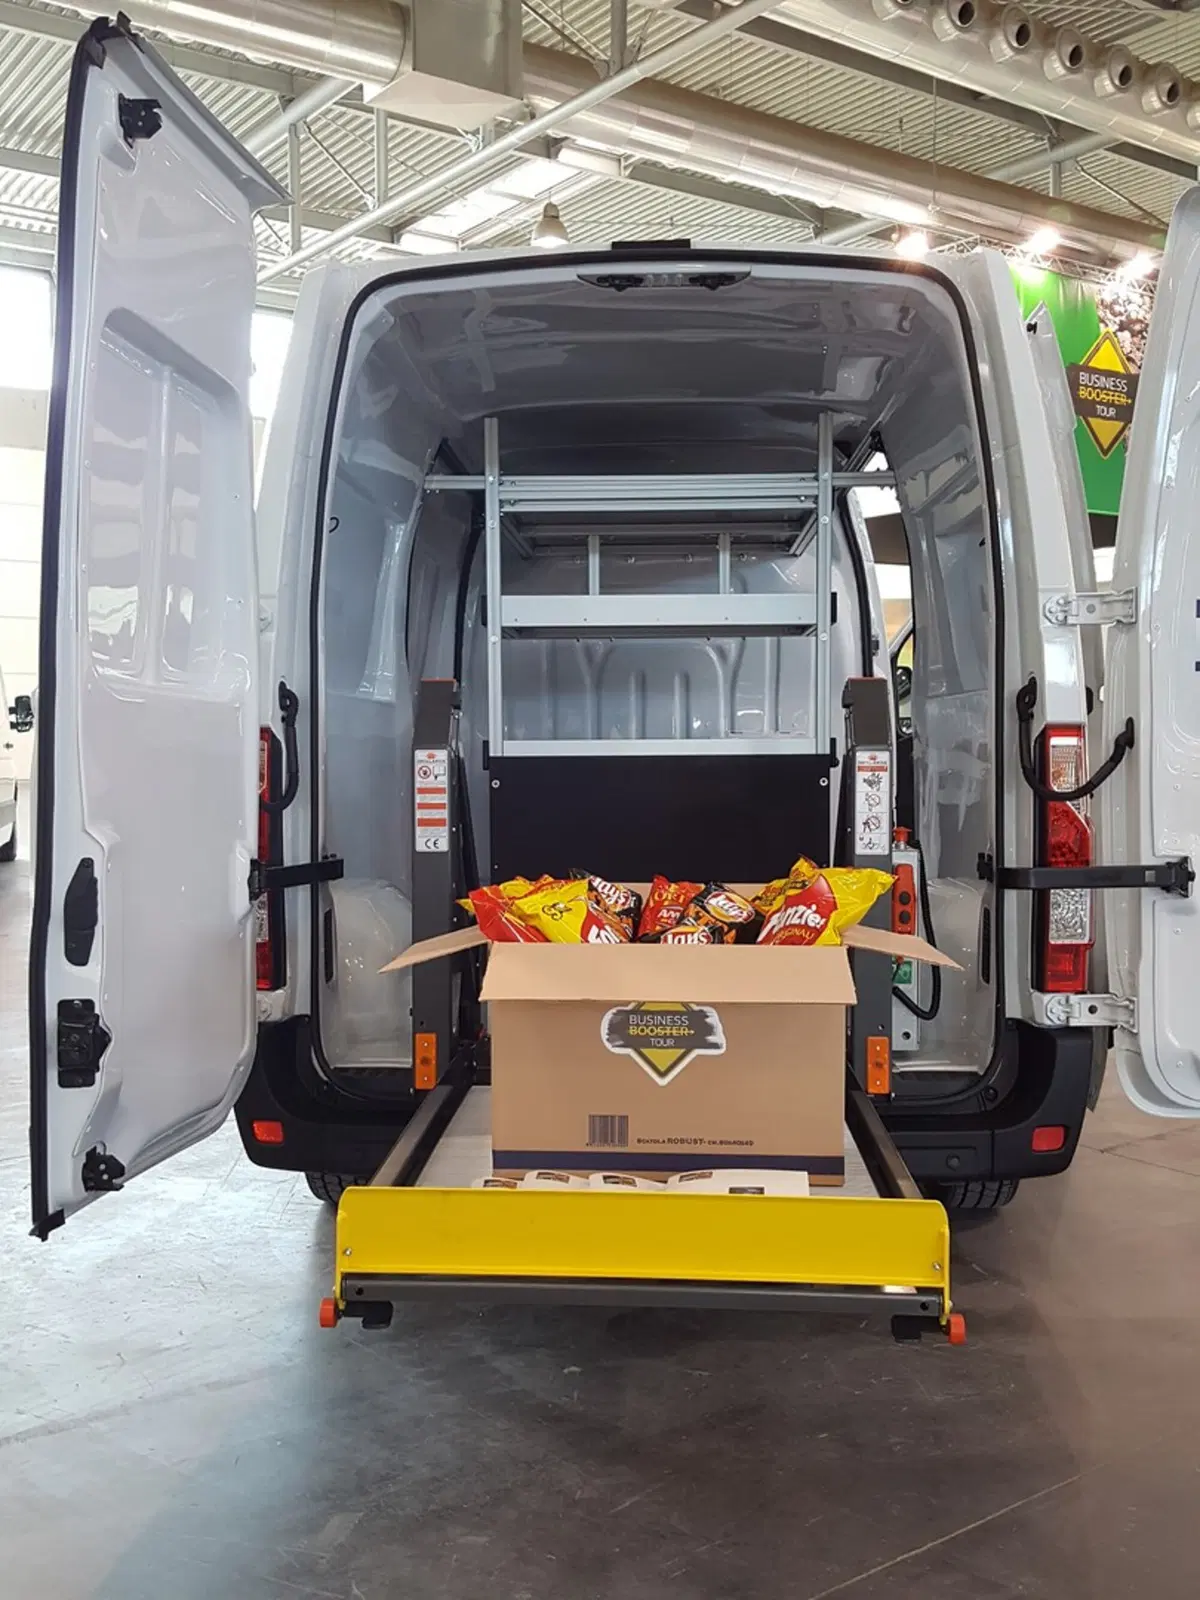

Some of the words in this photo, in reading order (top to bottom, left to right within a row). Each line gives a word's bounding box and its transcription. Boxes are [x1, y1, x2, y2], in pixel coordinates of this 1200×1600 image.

[1079, 371, 1128, 392] BUSINESS
[1079, 386, 1128, 406] BOOSTER
[1096, 404, 1117, 418] TOUR
[628, 1014, 690, 1026] BUSINESS
[629, 1026, 689, 1037] BOOSTER
[650, 1037, 676, 1047] TOUR
